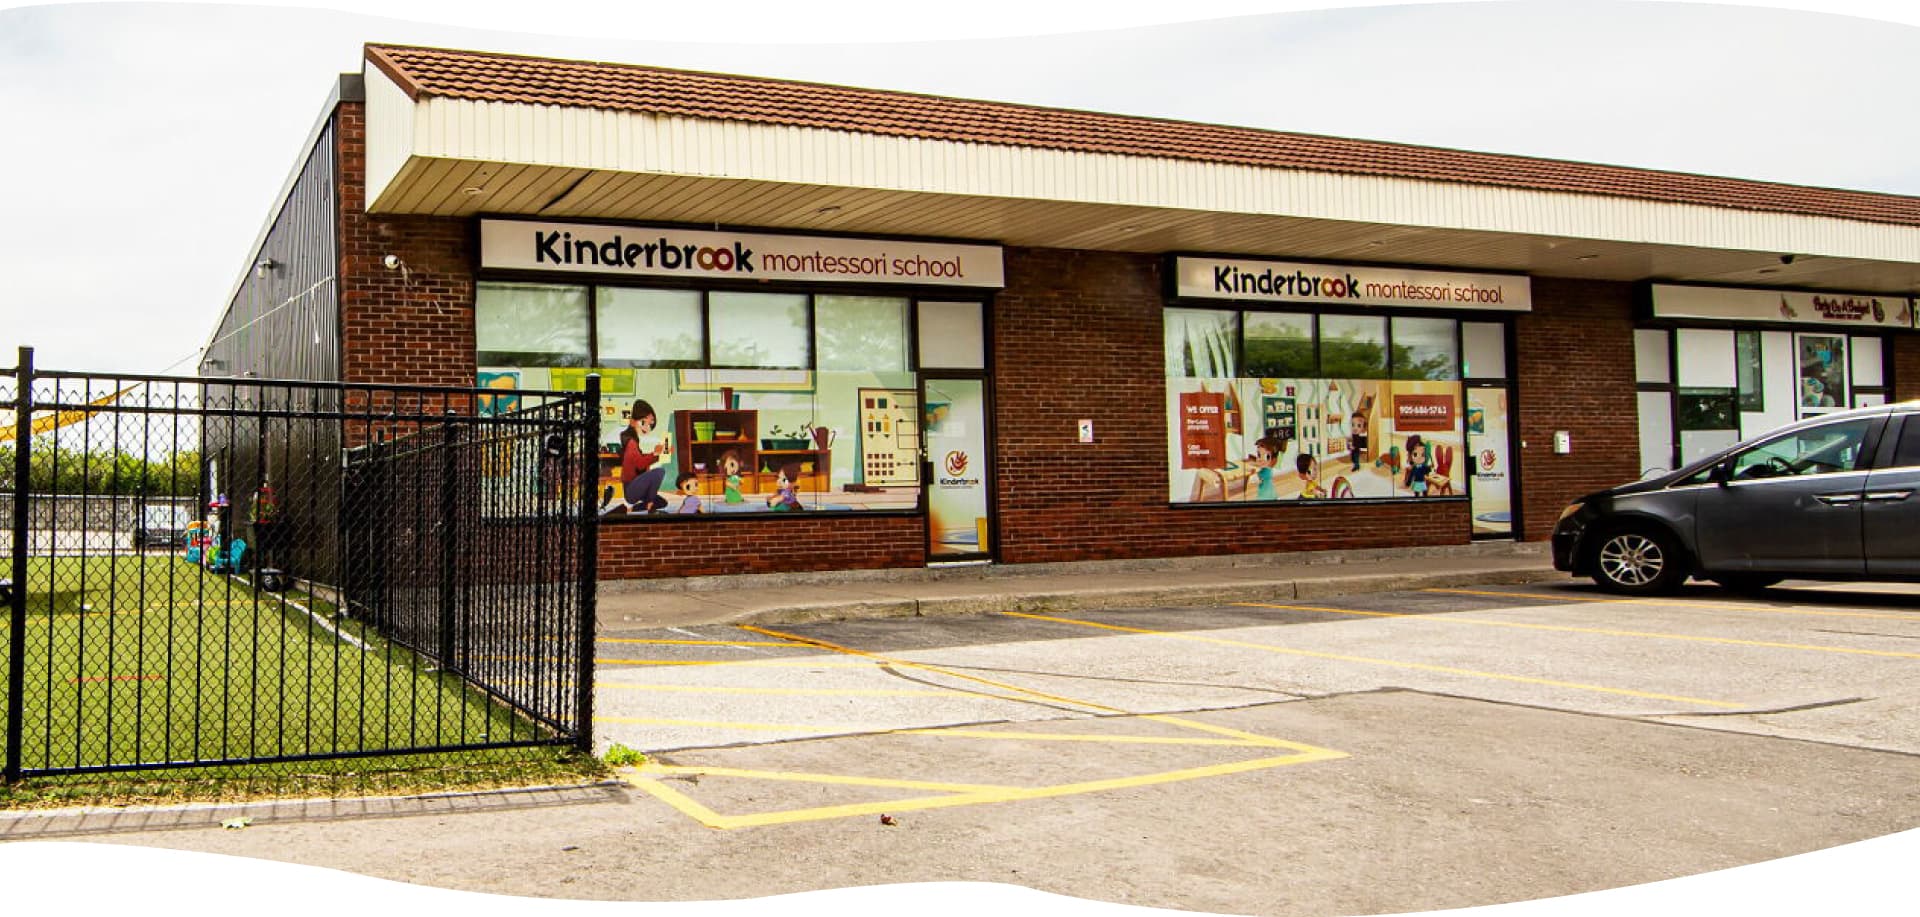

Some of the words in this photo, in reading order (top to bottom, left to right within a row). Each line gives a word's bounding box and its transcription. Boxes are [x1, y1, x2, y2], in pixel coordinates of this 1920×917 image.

[535, 231, 754, 273] Kinderbrook
[762, 251, 886, 276] montessori
[892, 255, 964, 278] school
[1214, 266, 1360, 299] Kinderbrook
[1366, 281, 1450, 301] montessori
[1455, 284, 1504, 304] school
